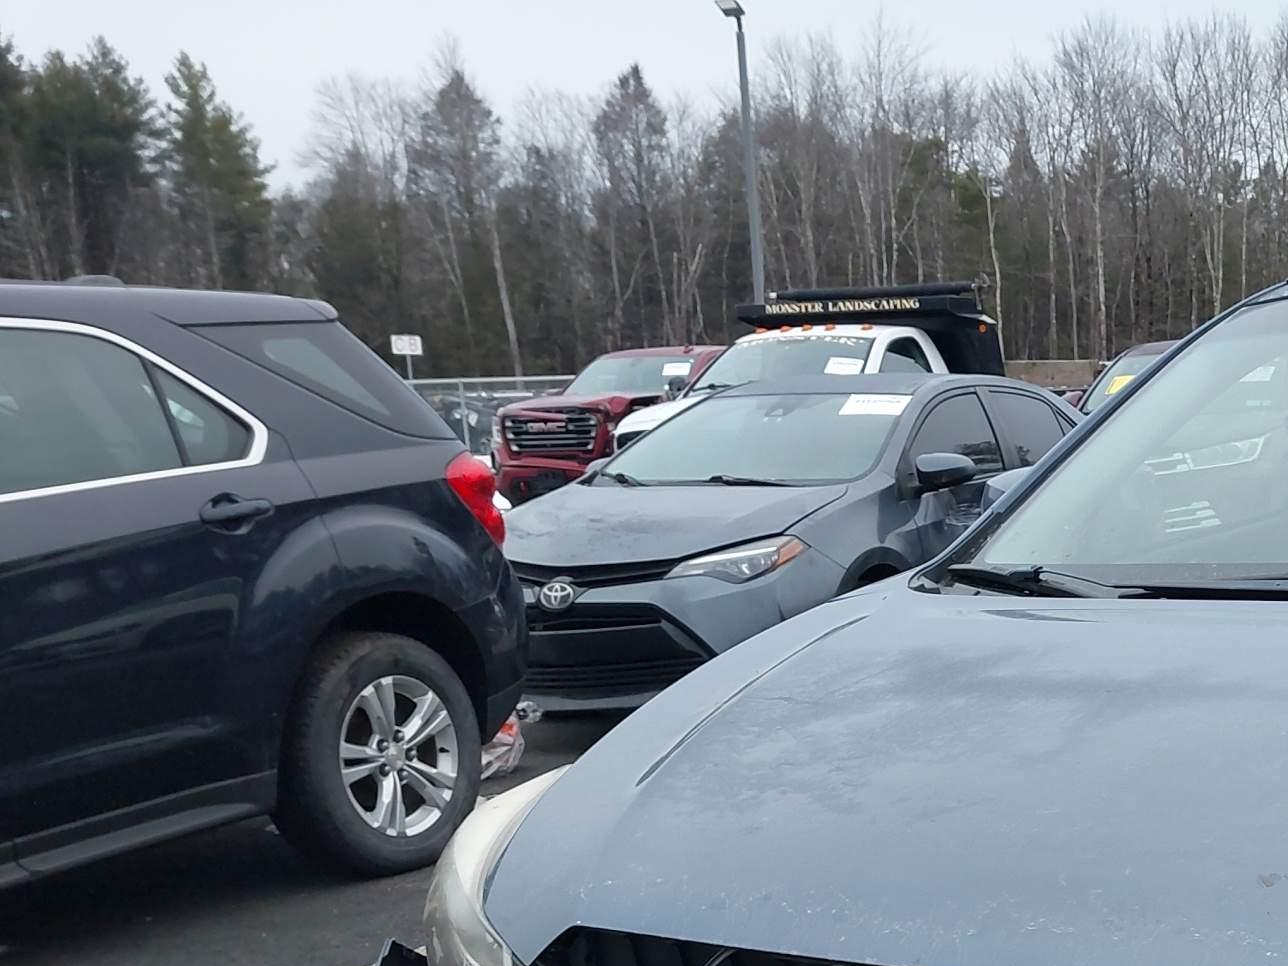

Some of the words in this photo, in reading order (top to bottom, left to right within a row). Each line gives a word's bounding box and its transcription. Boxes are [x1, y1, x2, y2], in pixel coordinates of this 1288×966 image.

[765, 301, 824, 314] MONSTER
[828, 297, 920, 312] LANDSCAPING
[527, 422, 566, 432] GMC
